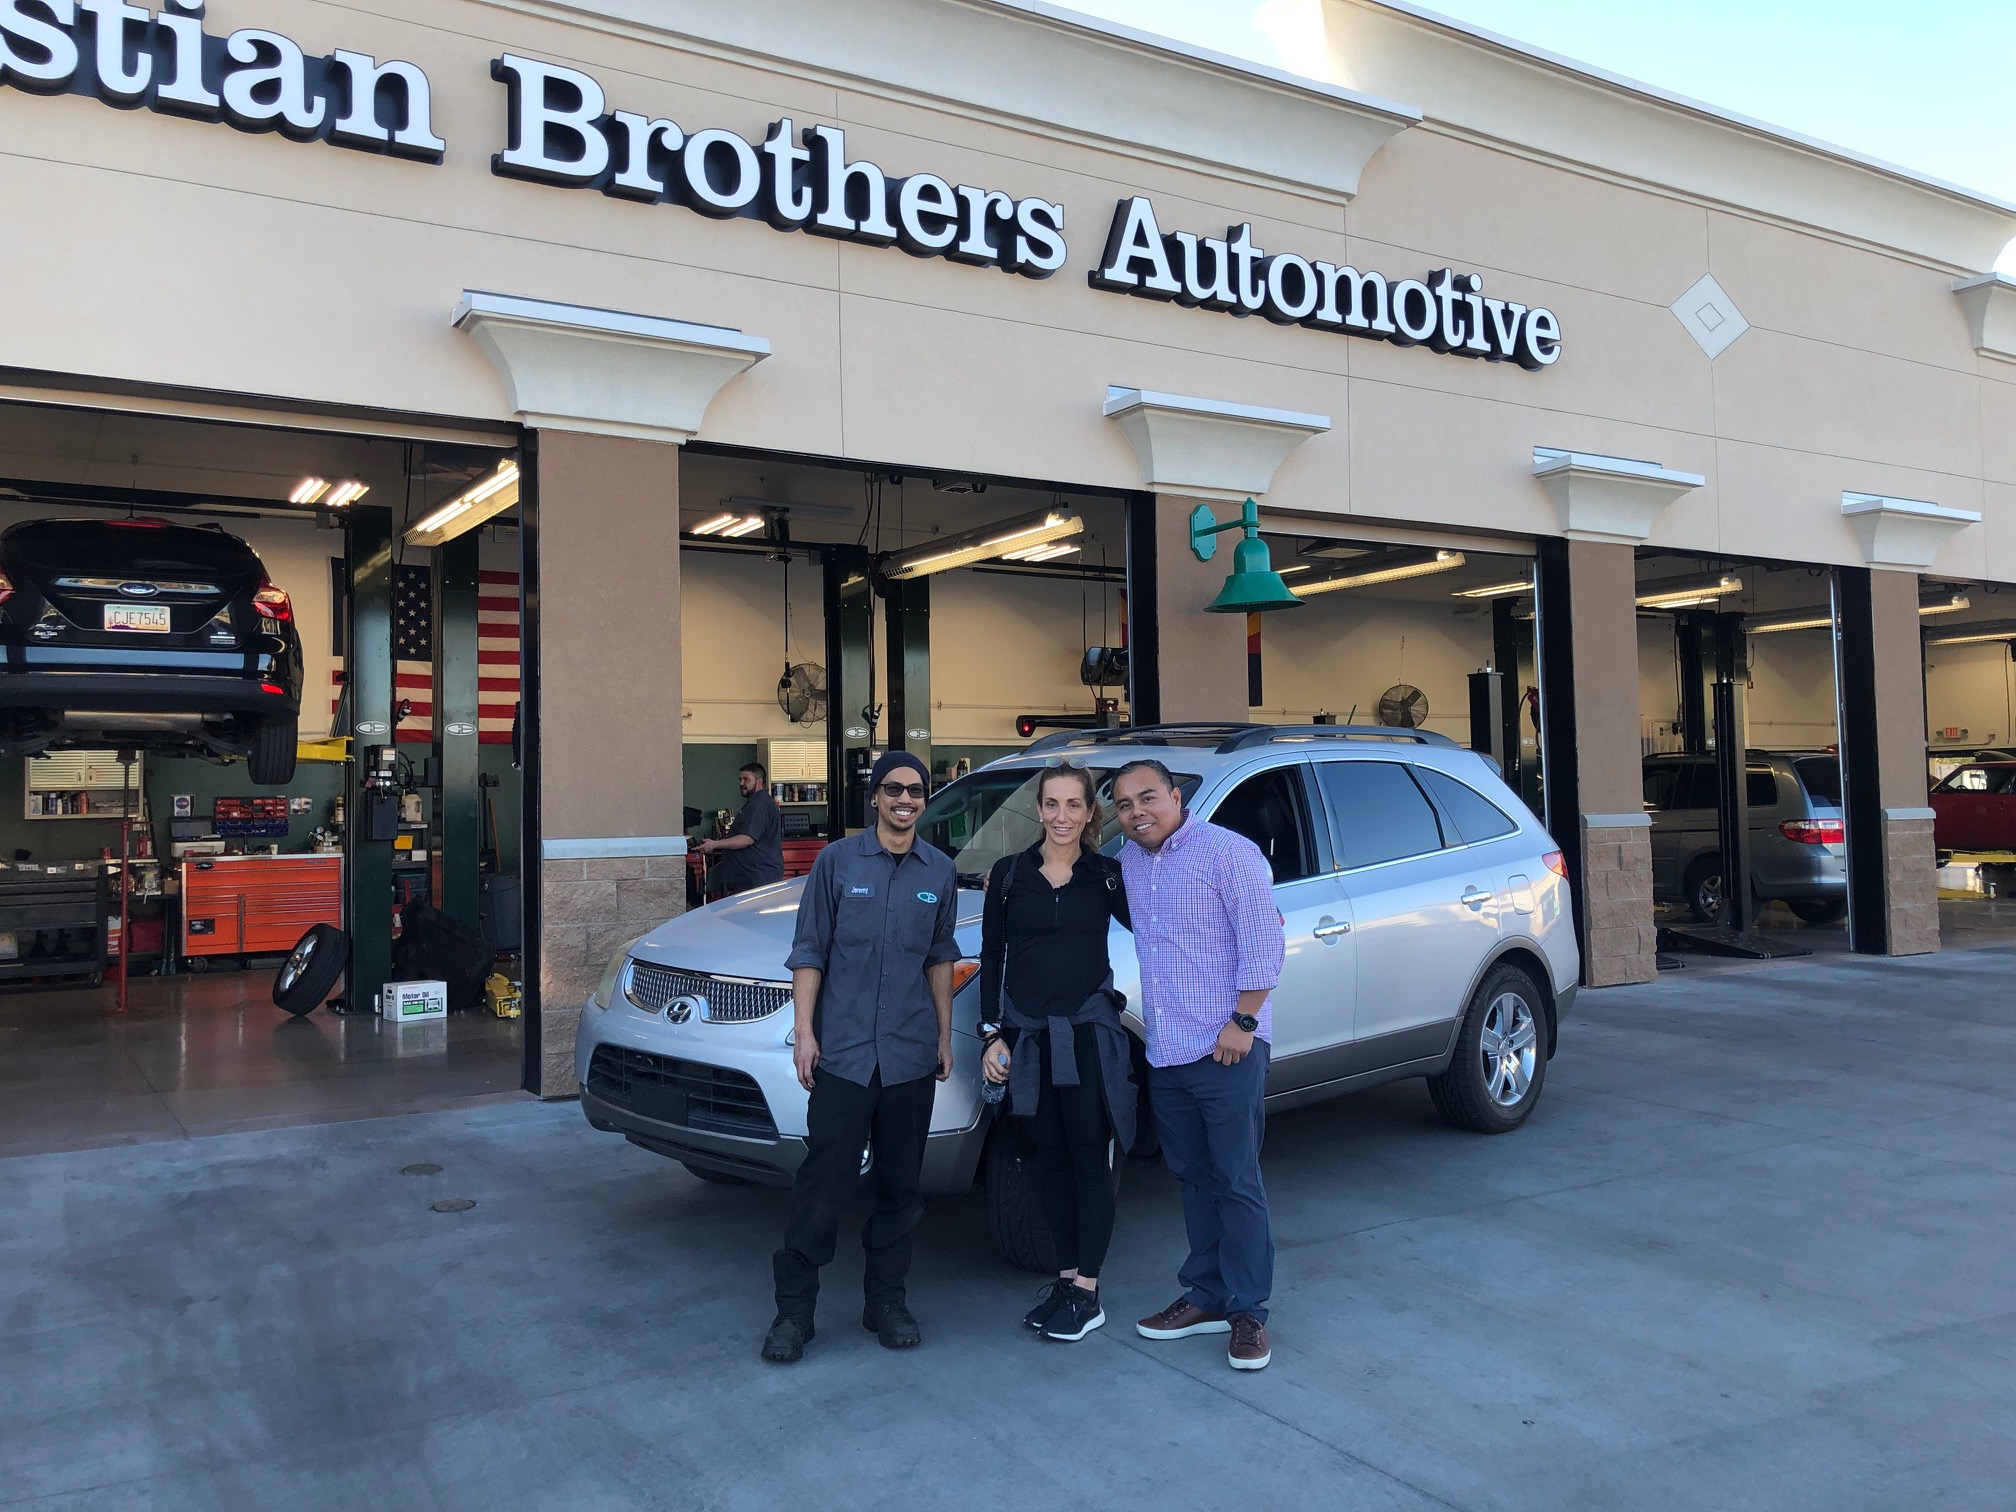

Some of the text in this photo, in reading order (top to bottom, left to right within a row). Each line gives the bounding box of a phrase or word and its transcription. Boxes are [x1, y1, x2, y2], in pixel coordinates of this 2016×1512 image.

[0, 0, 1563, 366] stian Brothers Automotive
[113, 611, 167, 626] CJE7545
[1945, 727, 1959, 737] EXIT
[851, 886, 869, 895] Jeremy
[421, 991, 430, 999] Oil
